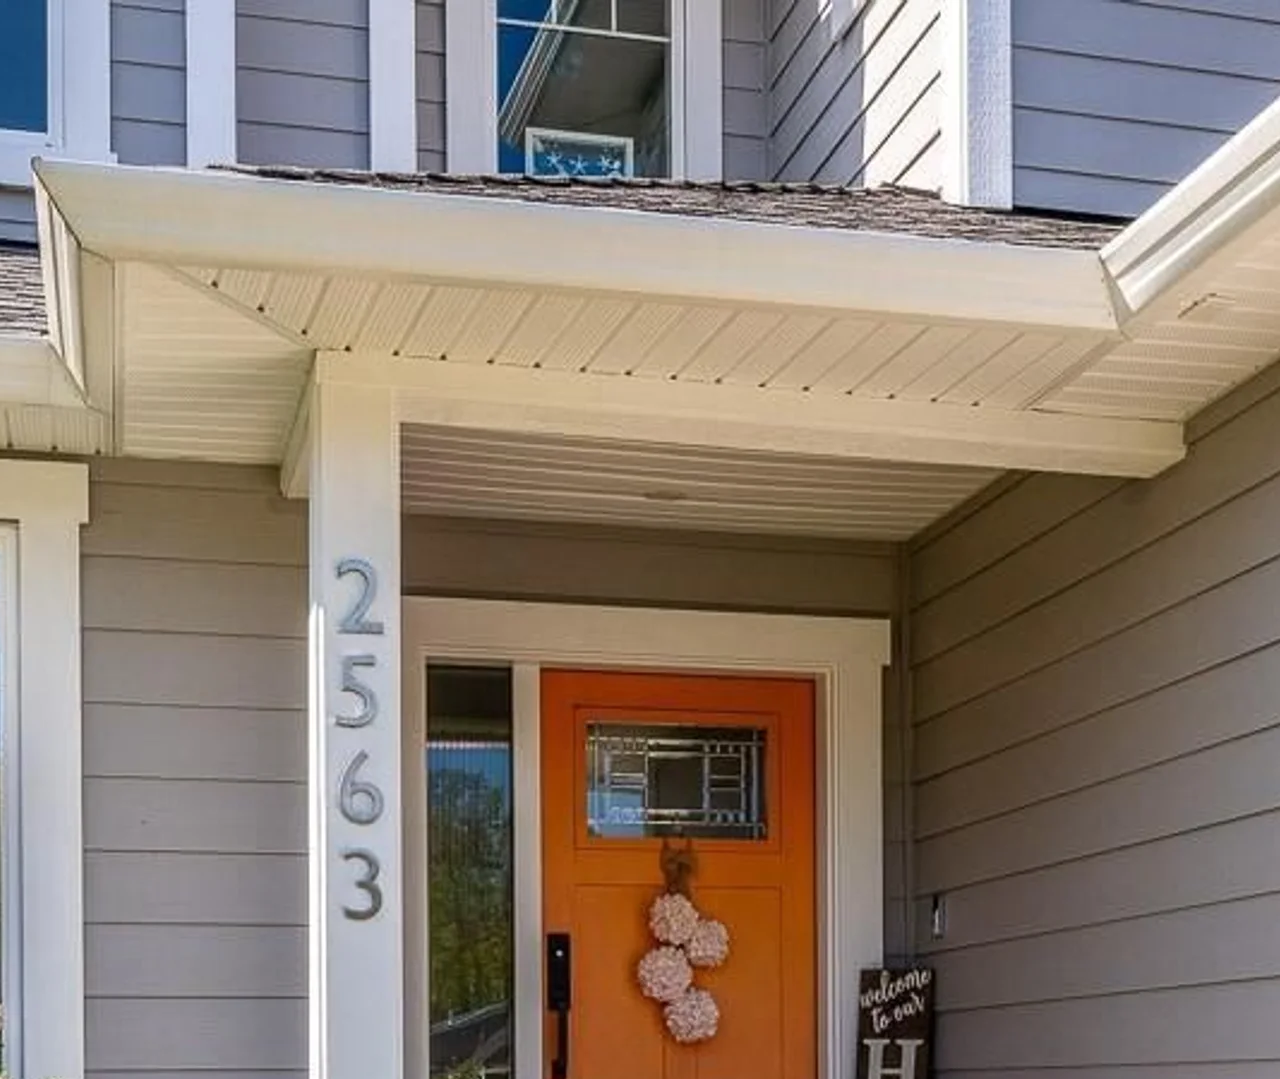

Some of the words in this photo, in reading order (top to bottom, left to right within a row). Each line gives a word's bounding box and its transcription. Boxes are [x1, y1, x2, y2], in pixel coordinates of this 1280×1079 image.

[334, 558, 385, 922] 2563
[860, 968, 932, 1010] welcome
[871, 1006, 893, 1034] to
[893, 991, 925, 1022] our
